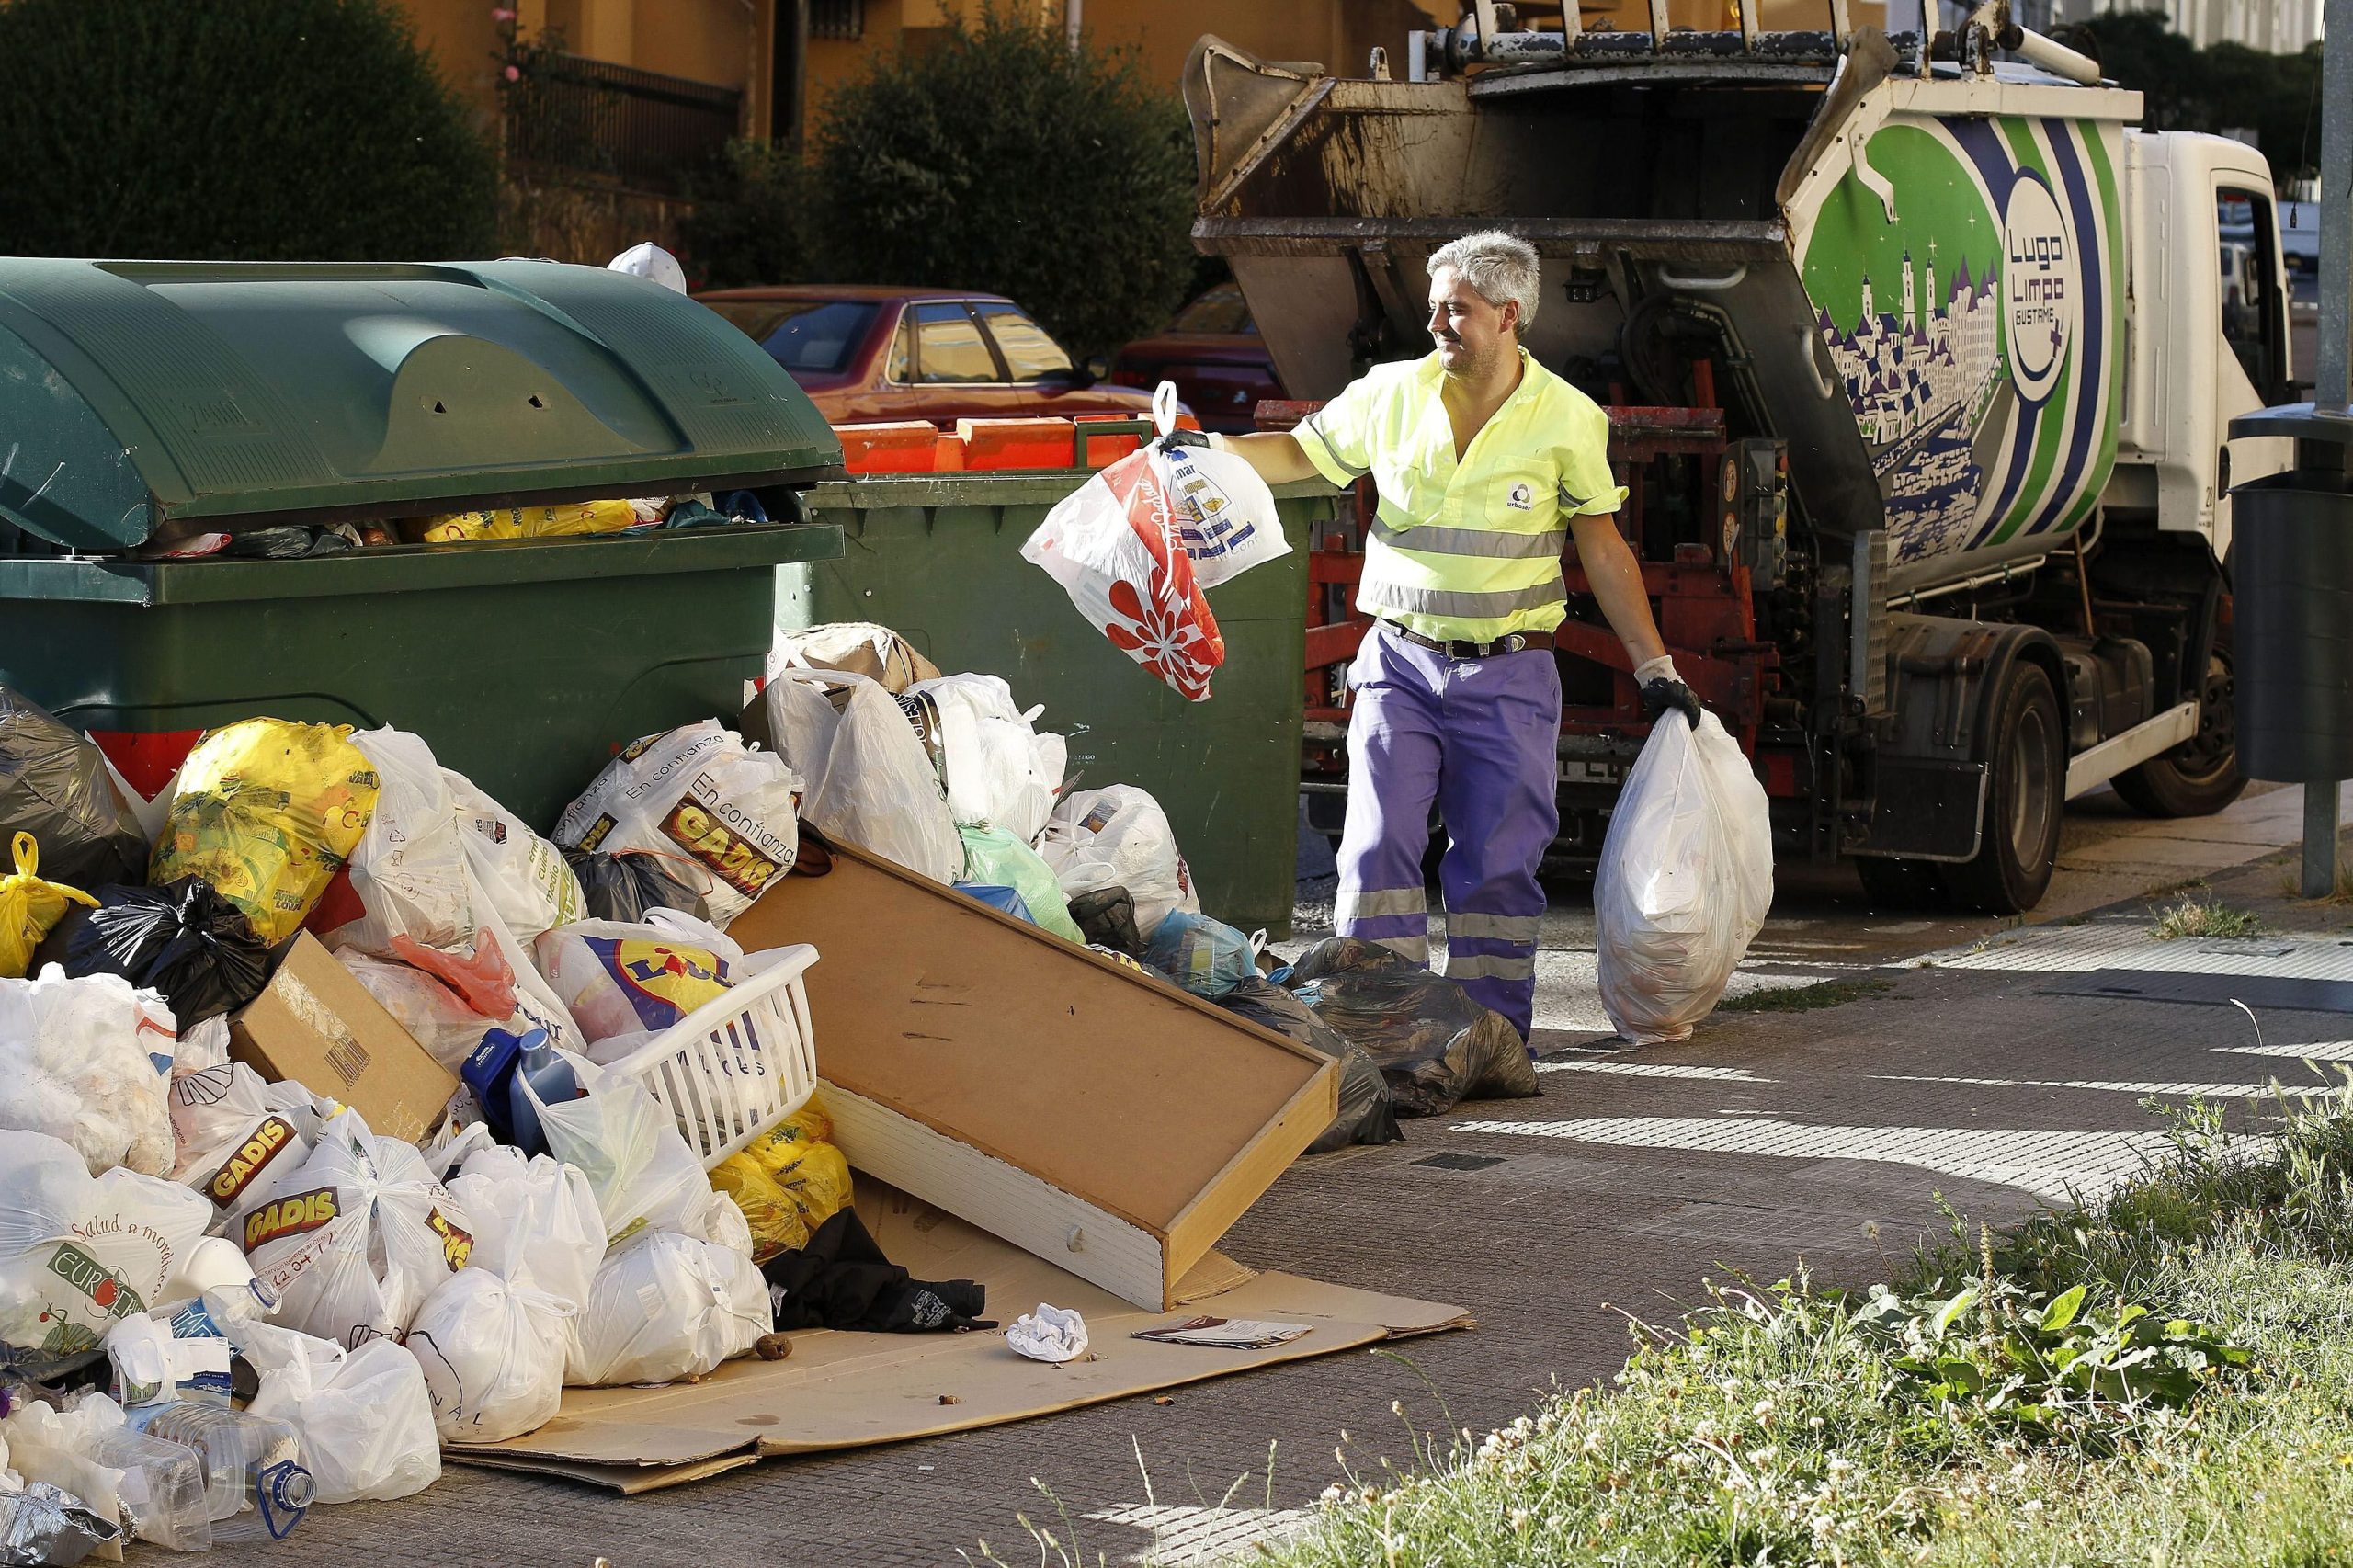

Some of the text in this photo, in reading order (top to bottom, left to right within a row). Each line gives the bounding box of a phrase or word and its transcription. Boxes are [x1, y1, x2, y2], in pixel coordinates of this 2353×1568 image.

[2008, 229, 2063, 270] Lugo
[2012, 273, 2063, 307] Limpo
[625, 782, 652, 800] En
[652, 735, 724, 781] confianza
[691, 771, 795, 864] En confianza
[676, 805, 776, 887] GADIS
[545, 864, 559, 905] medio
[213, 1119, 285, 1197] GADIS
[71, 1212, 122, 1242] Salud
[128, 1223, 138, 1234] a
[245, 1192, 337, 1243] GADIS
